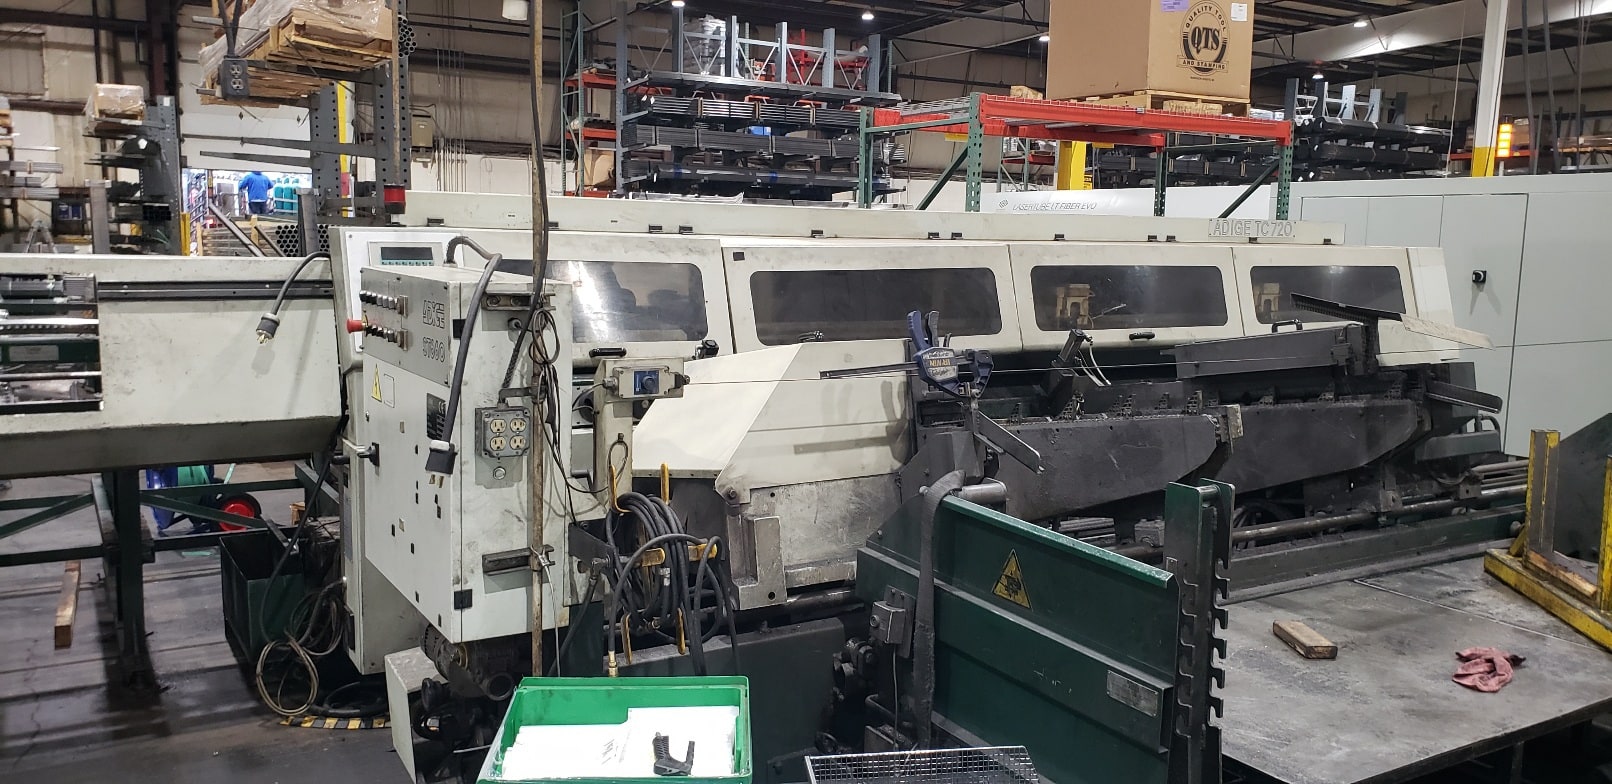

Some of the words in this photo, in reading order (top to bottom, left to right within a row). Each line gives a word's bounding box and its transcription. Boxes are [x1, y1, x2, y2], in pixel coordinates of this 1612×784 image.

[1185, 6, 1213, 28] QUALITY
[1215, 10, 1226, 32] TOOL
[1190, 26, 1220, 54] QTS
[1197, 61, 1225, 70] STAMPING
[1060, 202, 1081, 210] FIBER
[1213, 219, 1251, 236] ADIGE
